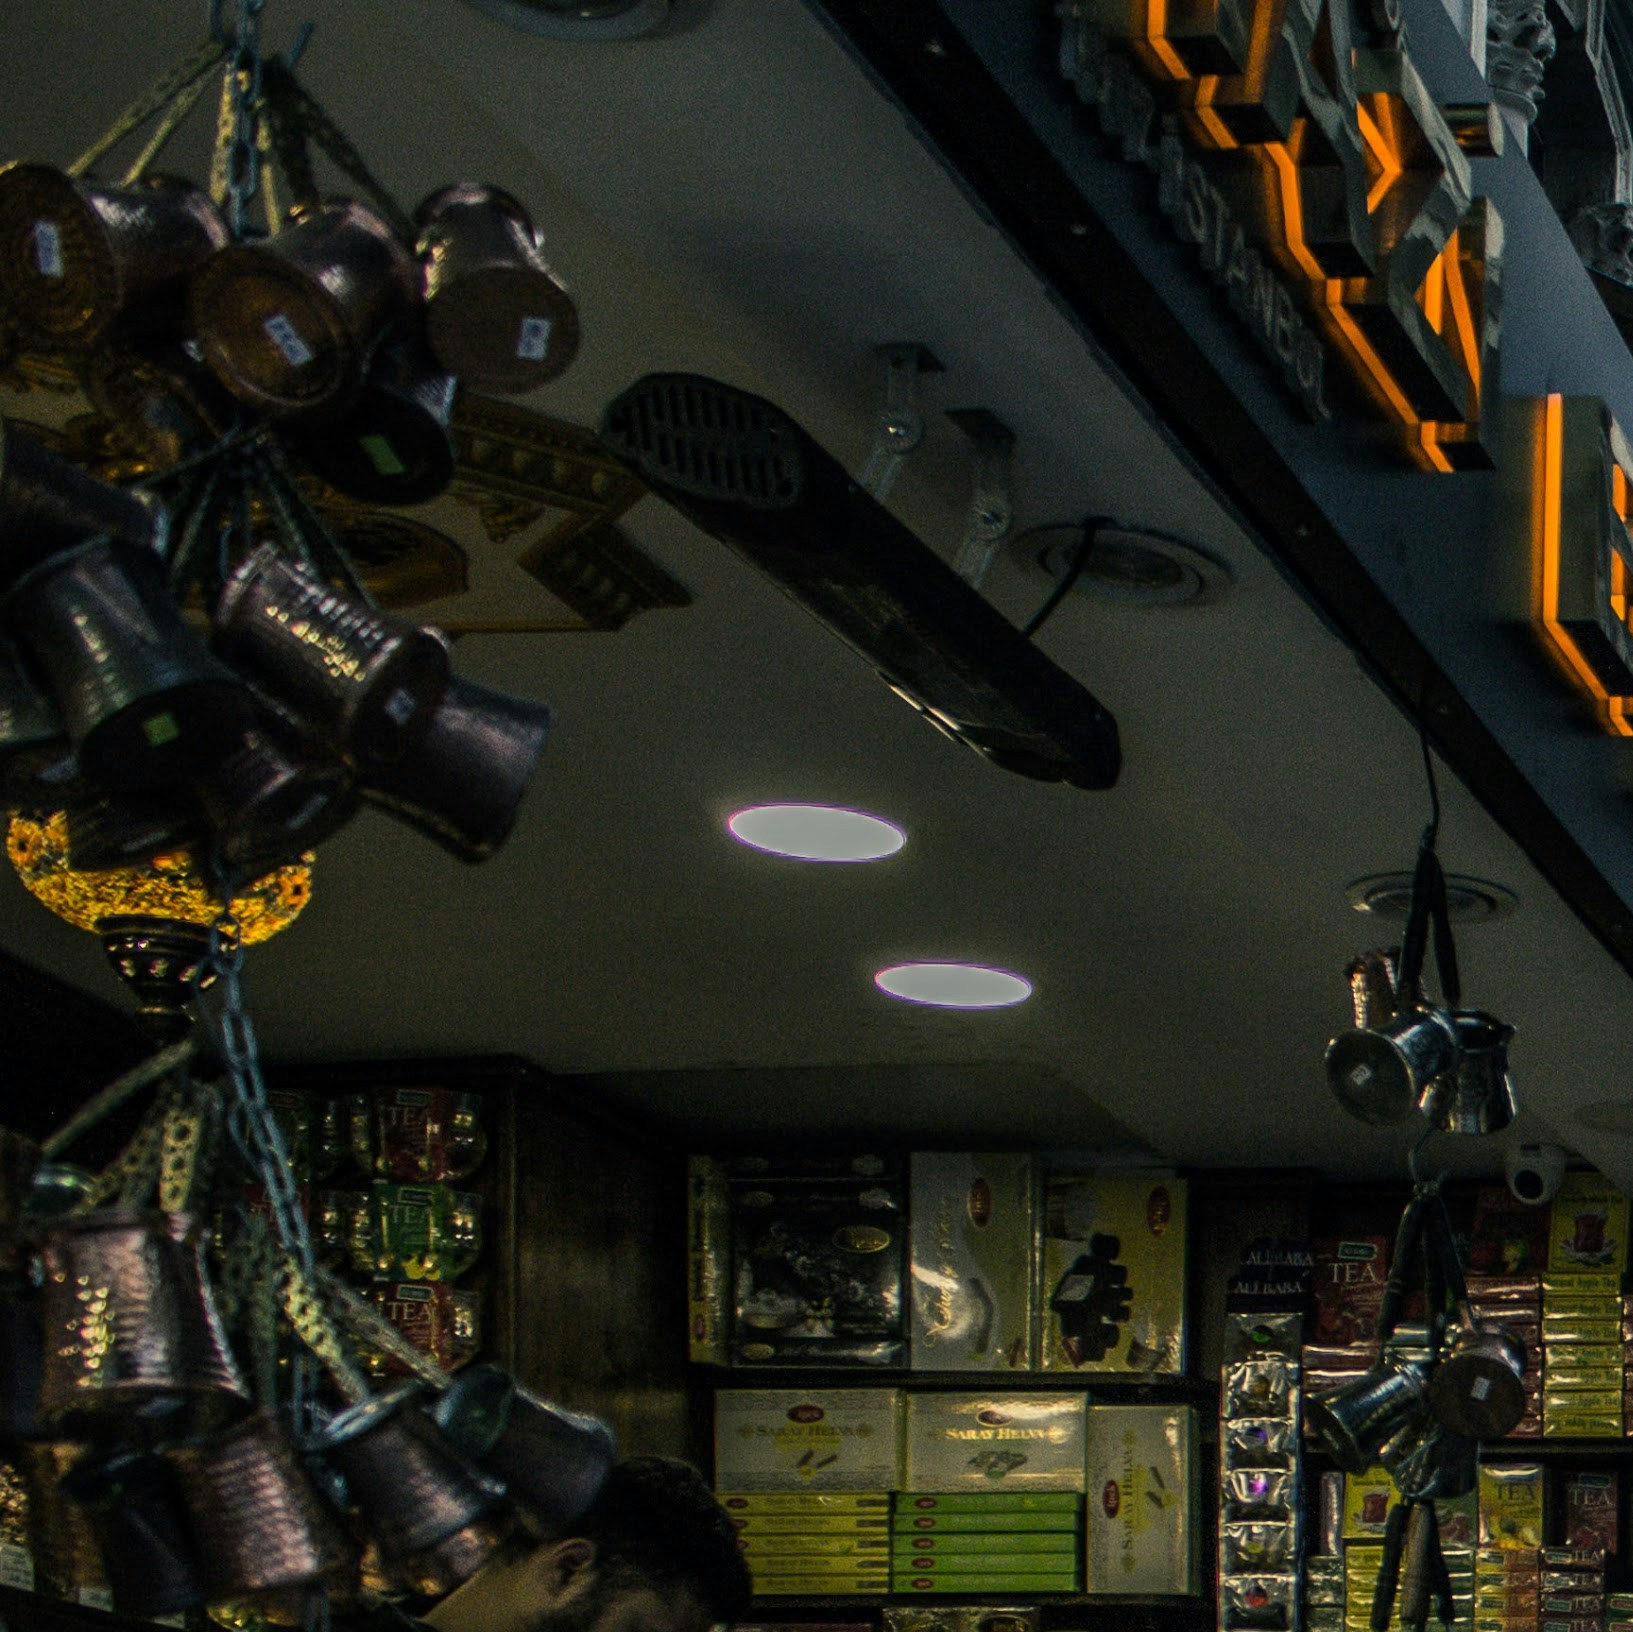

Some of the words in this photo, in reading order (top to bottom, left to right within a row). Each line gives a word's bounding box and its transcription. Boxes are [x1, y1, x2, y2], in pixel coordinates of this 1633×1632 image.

[1327, 1262, 1379, 1284] TEA
[945, 1428, 995, 1441] SARAY
[1495, 1483, 1536, 1501] TEA
[1571, 1489, 1613, 1506] TEA
[1573, 1549, 1601, 1561] TEA
[1570, 1620, 1600, 1632] TEA
